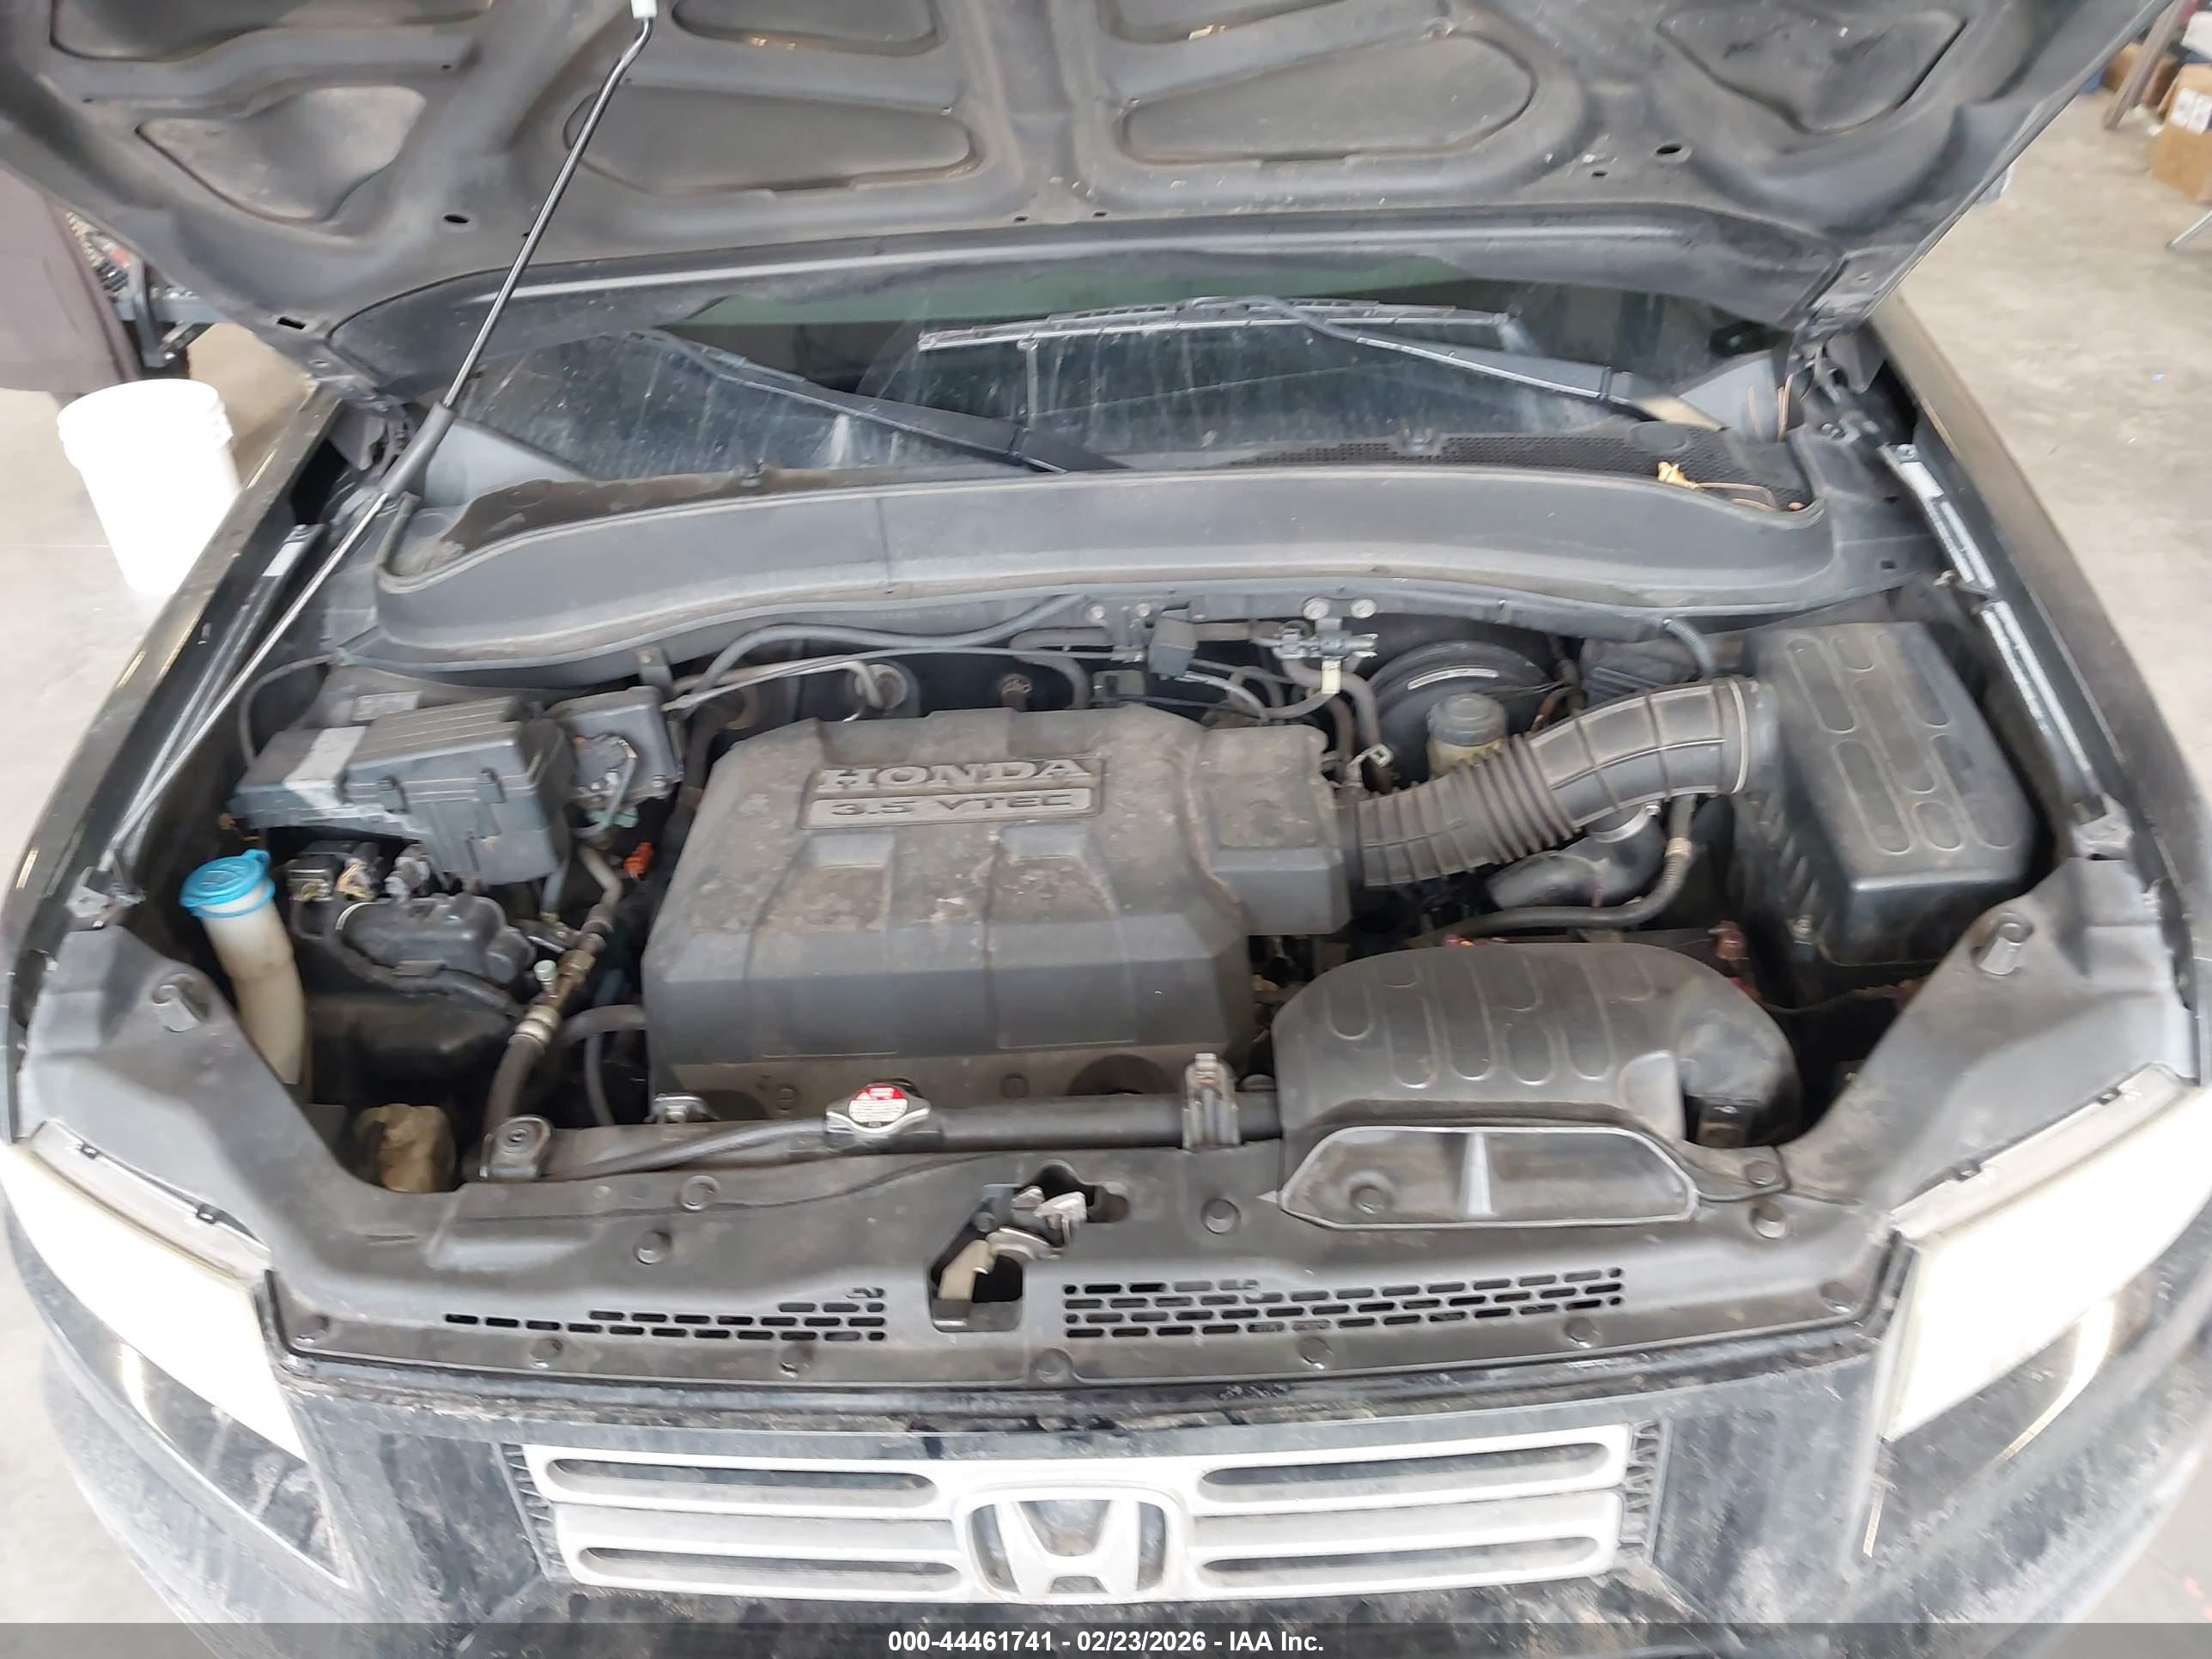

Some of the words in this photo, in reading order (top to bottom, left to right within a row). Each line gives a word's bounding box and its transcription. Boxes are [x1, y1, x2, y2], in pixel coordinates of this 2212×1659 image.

[817, 759, 1091, 793] HONDA
[830, 799, 915, 817] 3.5
[935, 793, 1073, 811] VTEC
